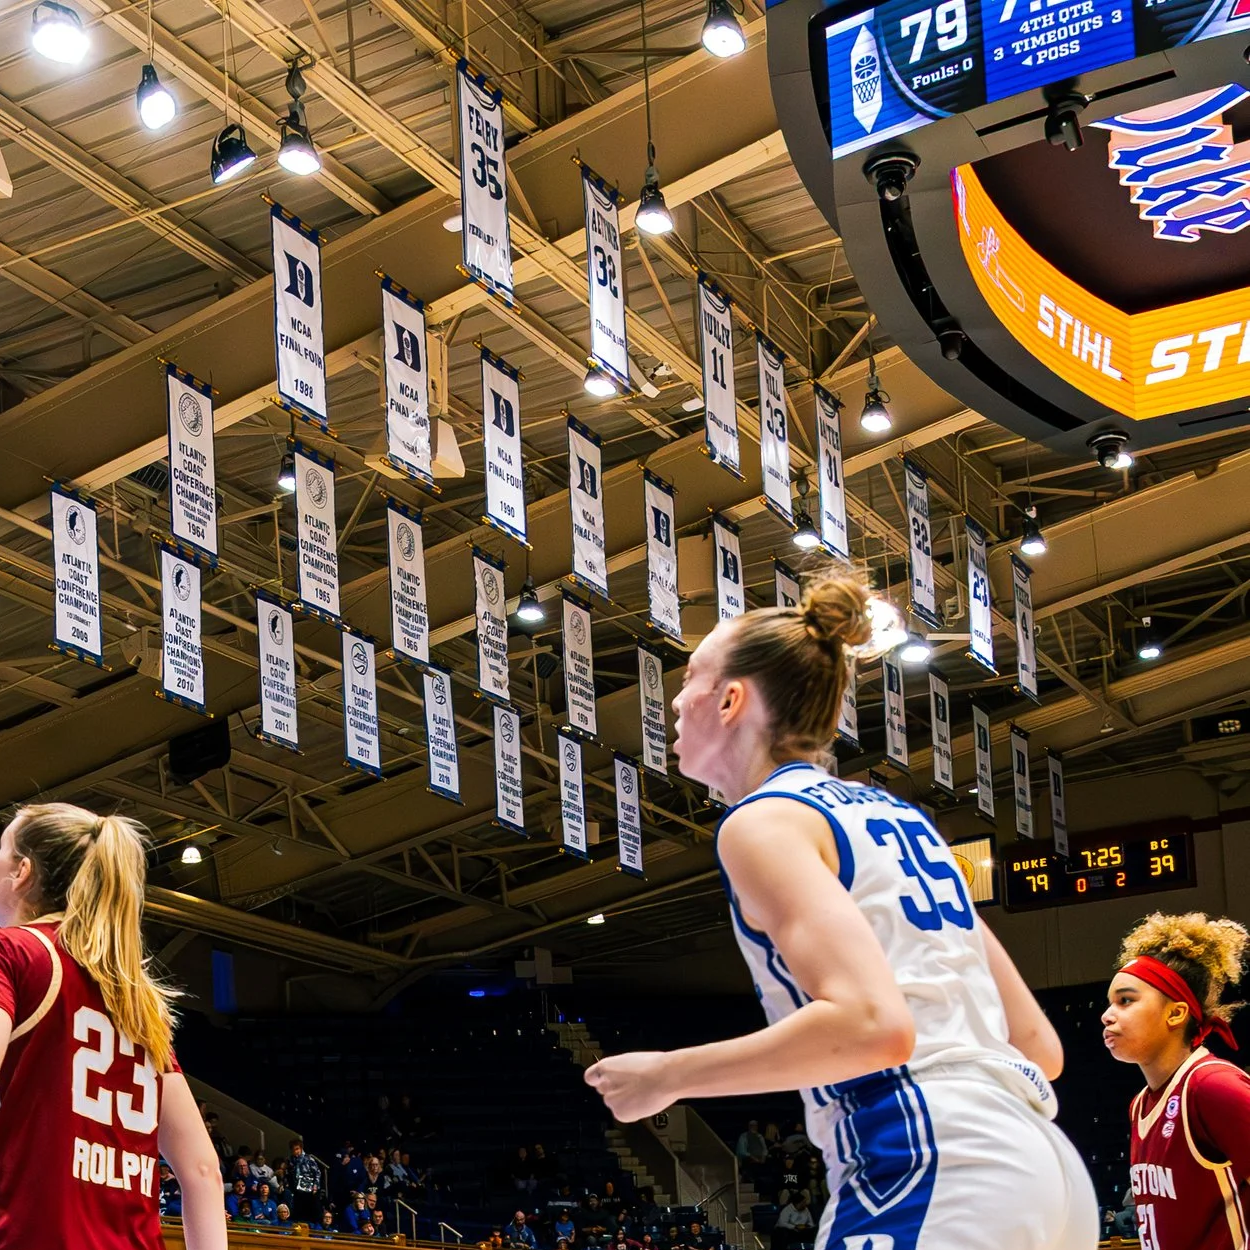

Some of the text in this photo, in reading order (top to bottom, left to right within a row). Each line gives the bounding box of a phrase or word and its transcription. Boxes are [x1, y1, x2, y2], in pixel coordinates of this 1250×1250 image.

[1019, 11, 1056, 35] 4TH
[1058, 2, 1095, 24] QTR
[900, 0, 968, 64] 79
[993, 9, 1122, 61] 3 TIMEOUTS 3
[1036, 40, 1081, 65] POSS
[911, 57, 973, 90] Fouls: 0
[470, 141, 503, 201] 35
[593, 244, 618, 299] 32
[291, 316, 312, 340] NCAA
[1037, 295, 1123, 381] STIHL
[279, 332, 323, 371] FINAL FOUR
[710, 346, 727, 391] 11
[399, 381, 419, 403] NCAA
[765, 398, 786, 443] 33
[179, 441, 207, 467] ATLANTIC
[497, 446, 513, 467] NCAA
[183, 459, 204, 479] COAST
[488, 461, 506, 482] FINAL
[826, 448, 840, 489] 31
[173, 468, 215, 500] CONFERENCE
[175, 484, 214, 514] CHAMPIONS
[500, 500, 515, 519] 1990
[187, 521, 206, 540] 1964
[304, 513, 331, 536] ATLANTIC
[309, 529, 328, 548] COAST
[912, 516, 931, 557] 22
[61, 552, 93, 574] ATLANTIC
[300, 538, 338, 566] CONFERENCE
[302, 553, 337, 579] CHAMPIONS
[396, 566, 421, 587] ATLANTIC
[68, 568, 89, 587] COAST
[56, 578, 98, 605] CONFERENCE
[314, 586, 331, 604] 1965
[400, 581, 417, 598] COAST
[972, 571, 988, 608] 23
[58, 592, 98, 618] CHAMPIONS
[393, 590, 427, 613] CONFERENCE
[169, 607, 196, 629] ATLANTIC
[395, 603, 426, 627] CHAMPIONS
[71, 626, 89, 643] 2009
[175, 623, 193, 640] COAST
[164, 632, 201, 657] CONFERENCE
[402, 636, 419, 652] 1966
[166, 646, 201, 670] CHAMPIONS
[265, 653, 290, 671] ATLANTIC
[176, 676, 195, 693] 2010
[269, 668, 287, 681] COAST
[262, 675, 297, 697] CONFERENCE
[350, 684, 373, 701] ATLANTIC
[264, 689, 296, 710] CHAMPIONS
[354, 696, 369, 711] COAST
[346, 704, 378, 725] CONFERENCE
[274, 719, 289, 733] 2011
[348, 718, 378, 737] CHAMPIONS
[1013, 858, 1048, 872] DUKE
[1081, 846, 1122, 868] 7:25
[1150, 854, 1175, 876] 39
[866, 818, 974, 931] 35
[1026, 873, 1049, 893] 79
[1076, 878, 1087, 893] 0
[1116, 872, 1126, 888] 2
[71, 1005, 159, 1135] 23
[72, 1136, 156, 1198] ROLPH
[1131, 1163, 1177, 1200] STON
